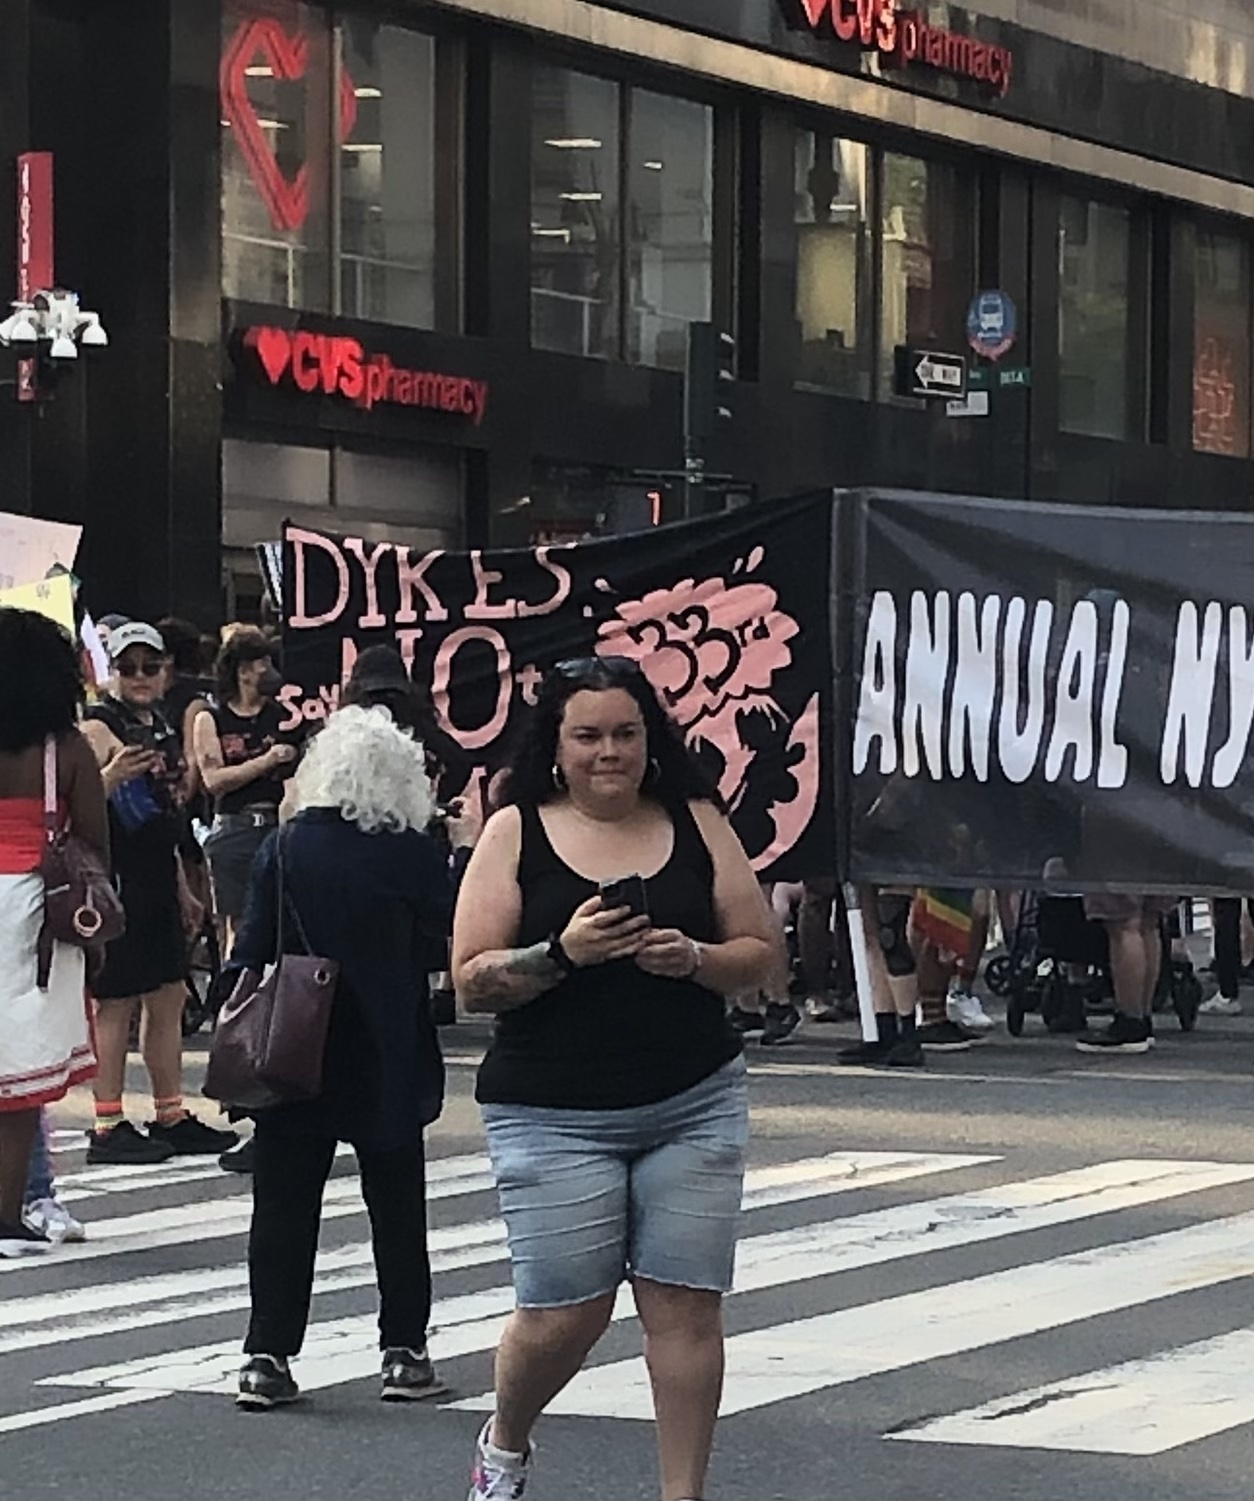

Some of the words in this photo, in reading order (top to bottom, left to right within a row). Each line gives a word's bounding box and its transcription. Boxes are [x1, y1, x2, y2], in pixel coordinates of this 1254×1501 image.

[832, 0, 896, 51] CVS
[902, 9, 1012, 98] pharmacy
[292, 331, 364, 399] CVS
[364, 354, 488, 426] pharmacy
[286, 527, 578, 629] DYKES
[627, 604, 771, 706] 33rd
[853, 590, 1129, 789] ANNUAL
